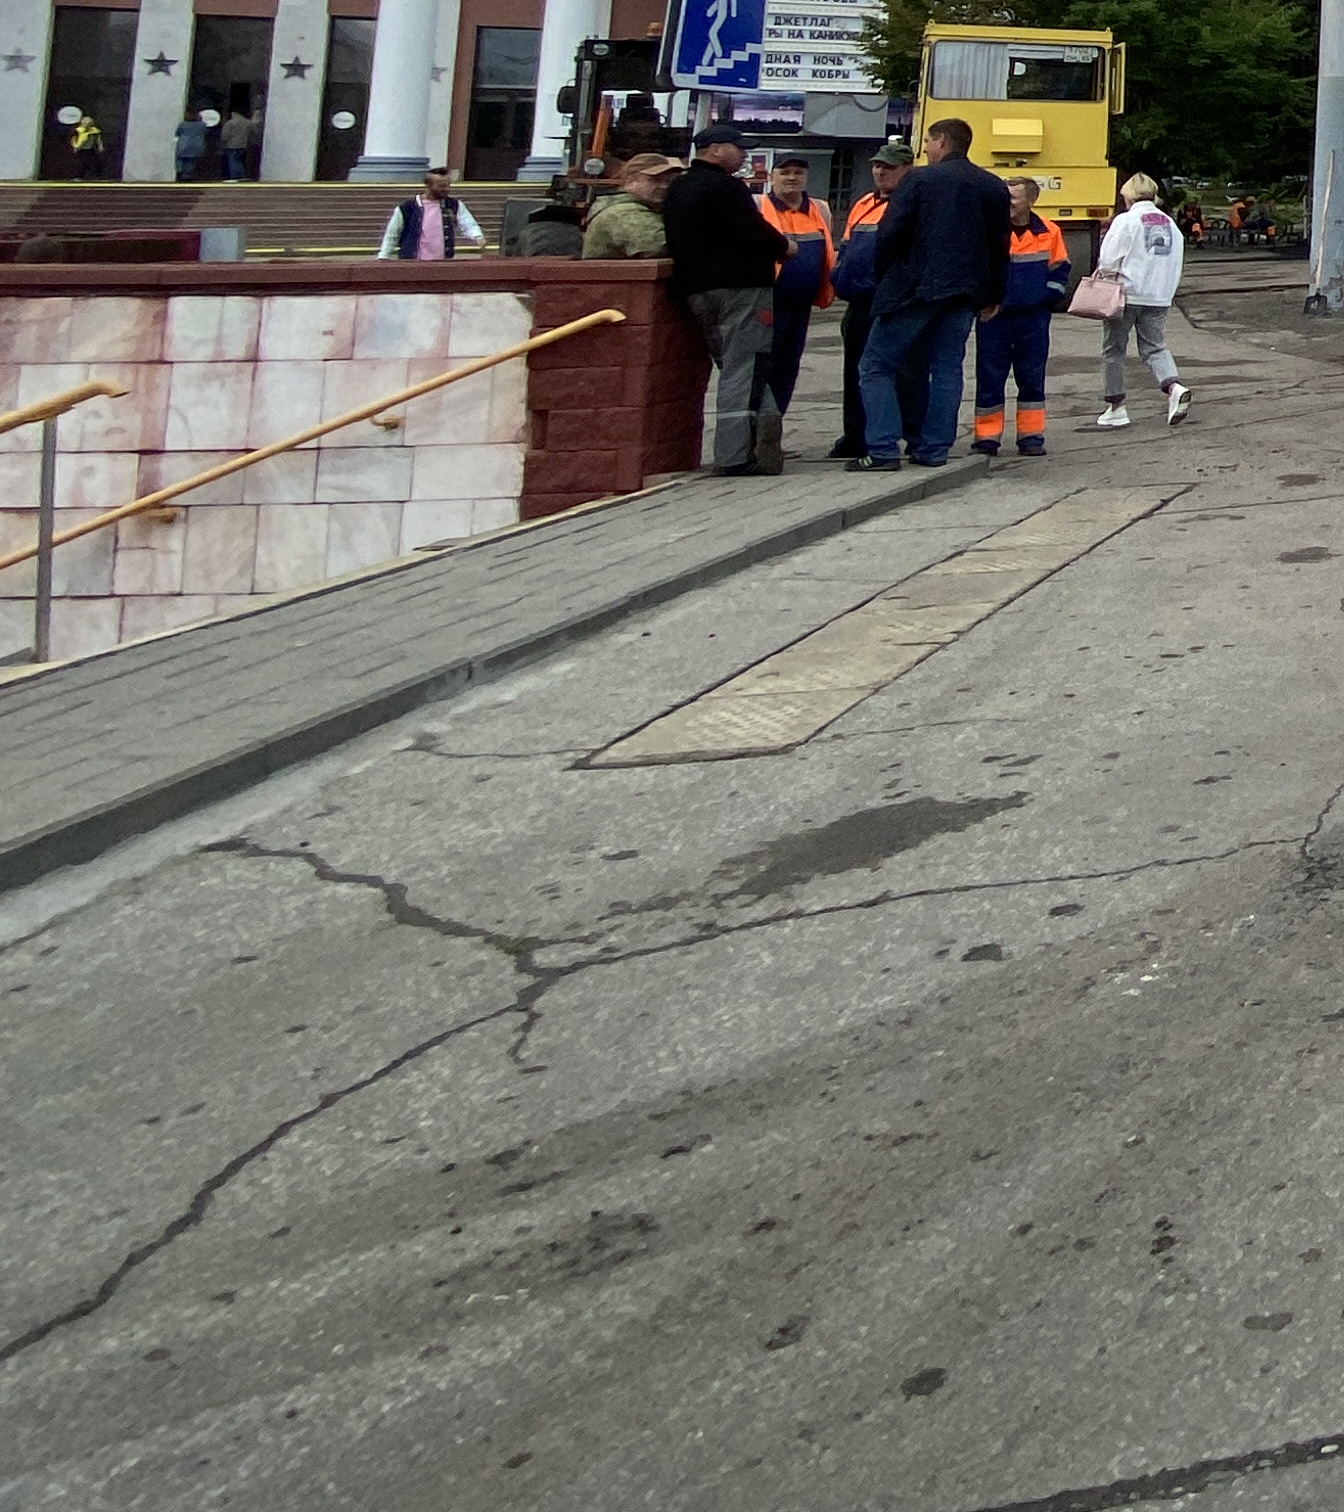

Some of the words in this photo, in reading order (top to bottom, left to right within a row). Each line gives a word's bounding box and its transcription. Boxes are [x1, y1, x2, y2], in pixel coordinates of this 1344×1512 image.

[787, 28, 805, 39] НА
[812, 54, 844, 66] НОЧЬ
[764, 67, 800, 78] ОСОК
[811, 68, 851, 79] КОБРЫ
